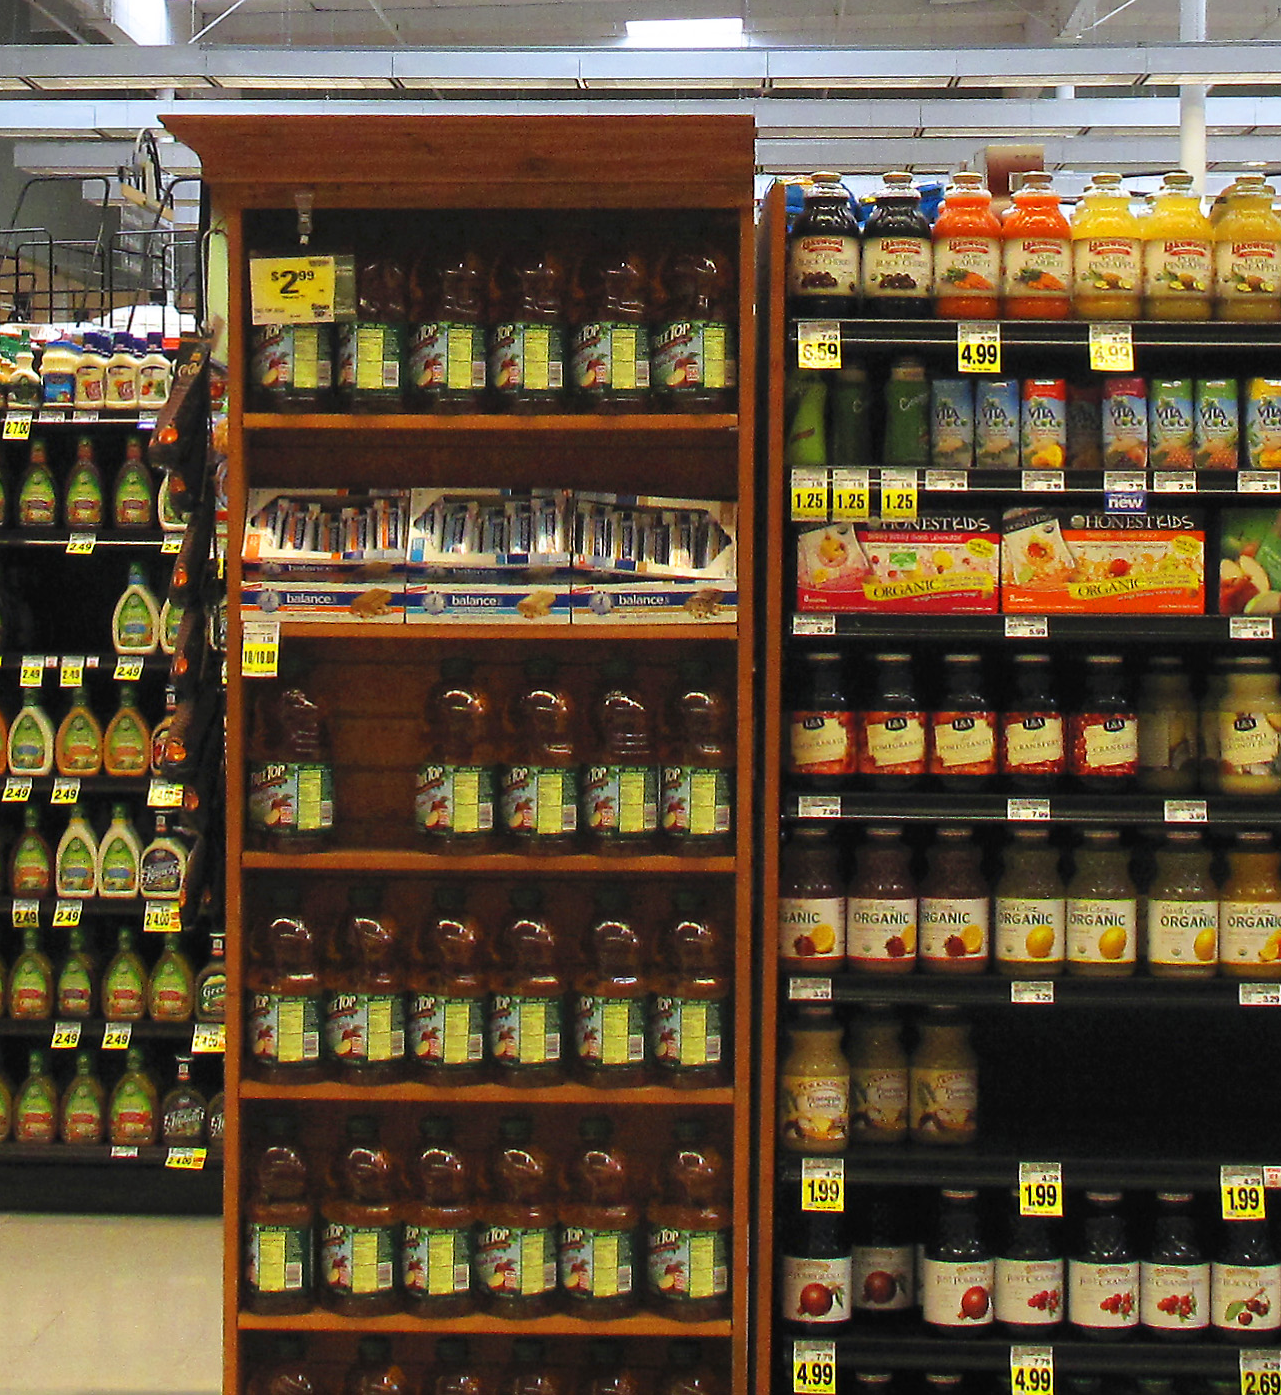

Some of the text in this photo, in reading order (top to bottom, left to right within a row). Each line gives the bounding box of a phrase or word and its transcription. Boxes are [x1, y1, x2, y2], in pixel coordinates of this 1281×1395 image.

[802, 344, 838, 362] 6.59
[962, 345, 998, 365] 4.99
[795, 493, 823, 509] 1.25
[836, 493, 865, 509] 1.25
[885, 493, 913, 509] 1.25
[1108, 493, 1143, 508] new
[69, 542, 92, 552] 2.49
[872, 578, 940, 599] ORGANIC
[1076, 577, 1145, 598] ORGANIC
[286, 592, 333, 606] balance
[450, 594, 498, 607] balance
[618, 593, 666, 606] balance
[117, 667, 140, 677] 2.49
[6, 788, 28, 798] 2.49
[54, 789, 77, 800] 2.49
[15, 911, 37, 924] 2.49
[57, 911, 79, 923] 2.49
[853, 912, 910, 924] ORGANIC
[1160, 916, 1217, 928] ORGANIC
[55, 1032, 78, 1044] 2.49
[105, 1032, 128, 1044] 2.49
[808, 1179, 840, 1203] 1.99
[1025, 1184, 1057, 1207] 1.99
[1226, 1186, 1261, 1210] 1.99
[796, 1362, 833, 1385] 4.99
[1014, 1368, 1051, 1392] 4.99
[1245, 1372, 1281, 1394] 2.69
